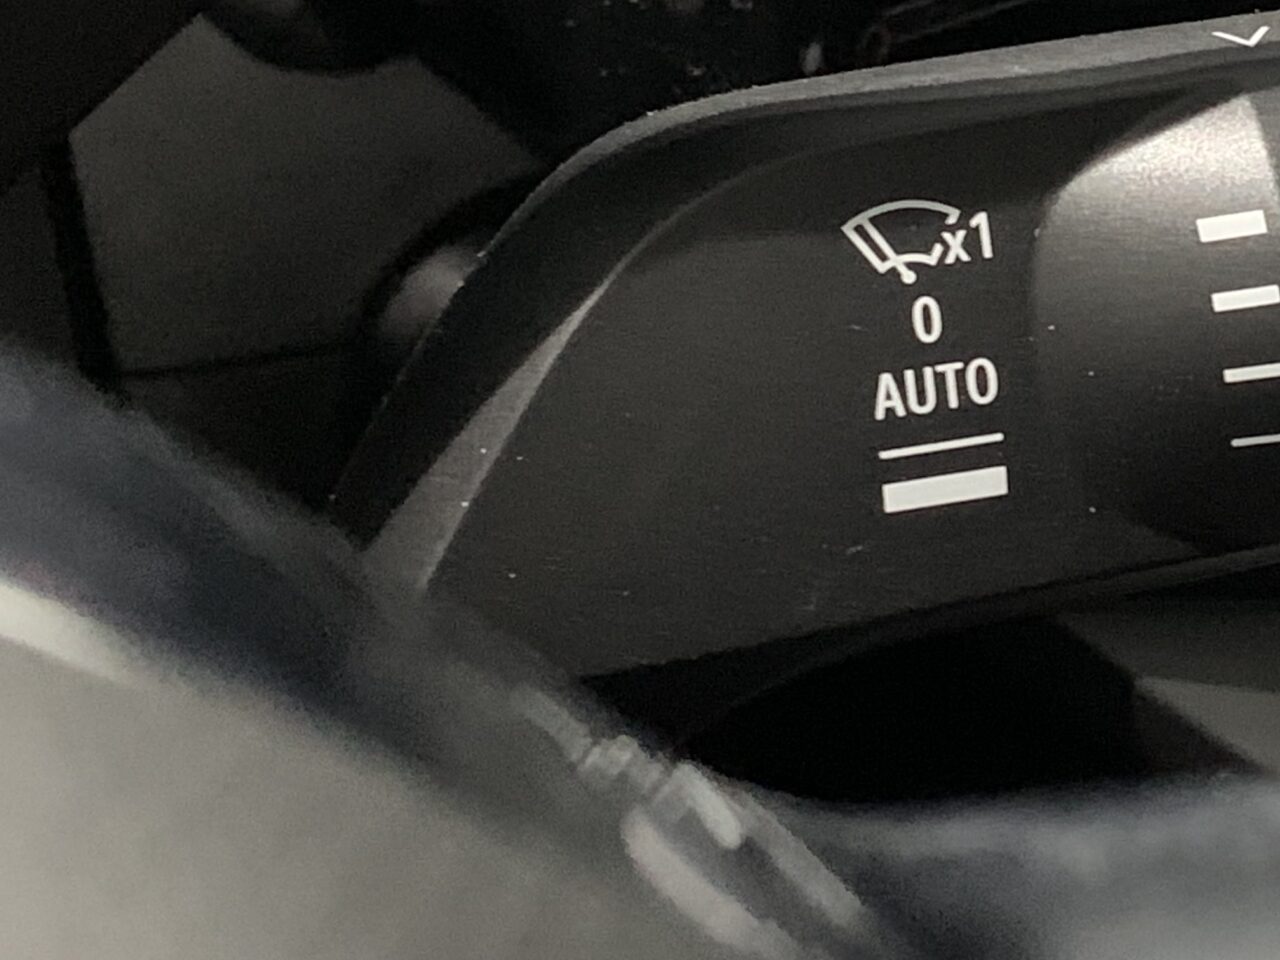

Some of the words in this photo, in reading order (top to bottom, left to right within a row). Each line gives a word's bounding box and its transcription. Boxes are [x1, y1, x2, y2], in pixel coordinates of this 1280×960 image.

[941, 211, 993, 264] x1
[911, 295, 943, 344] 0
[874, 357, 999, 421] AUTO
